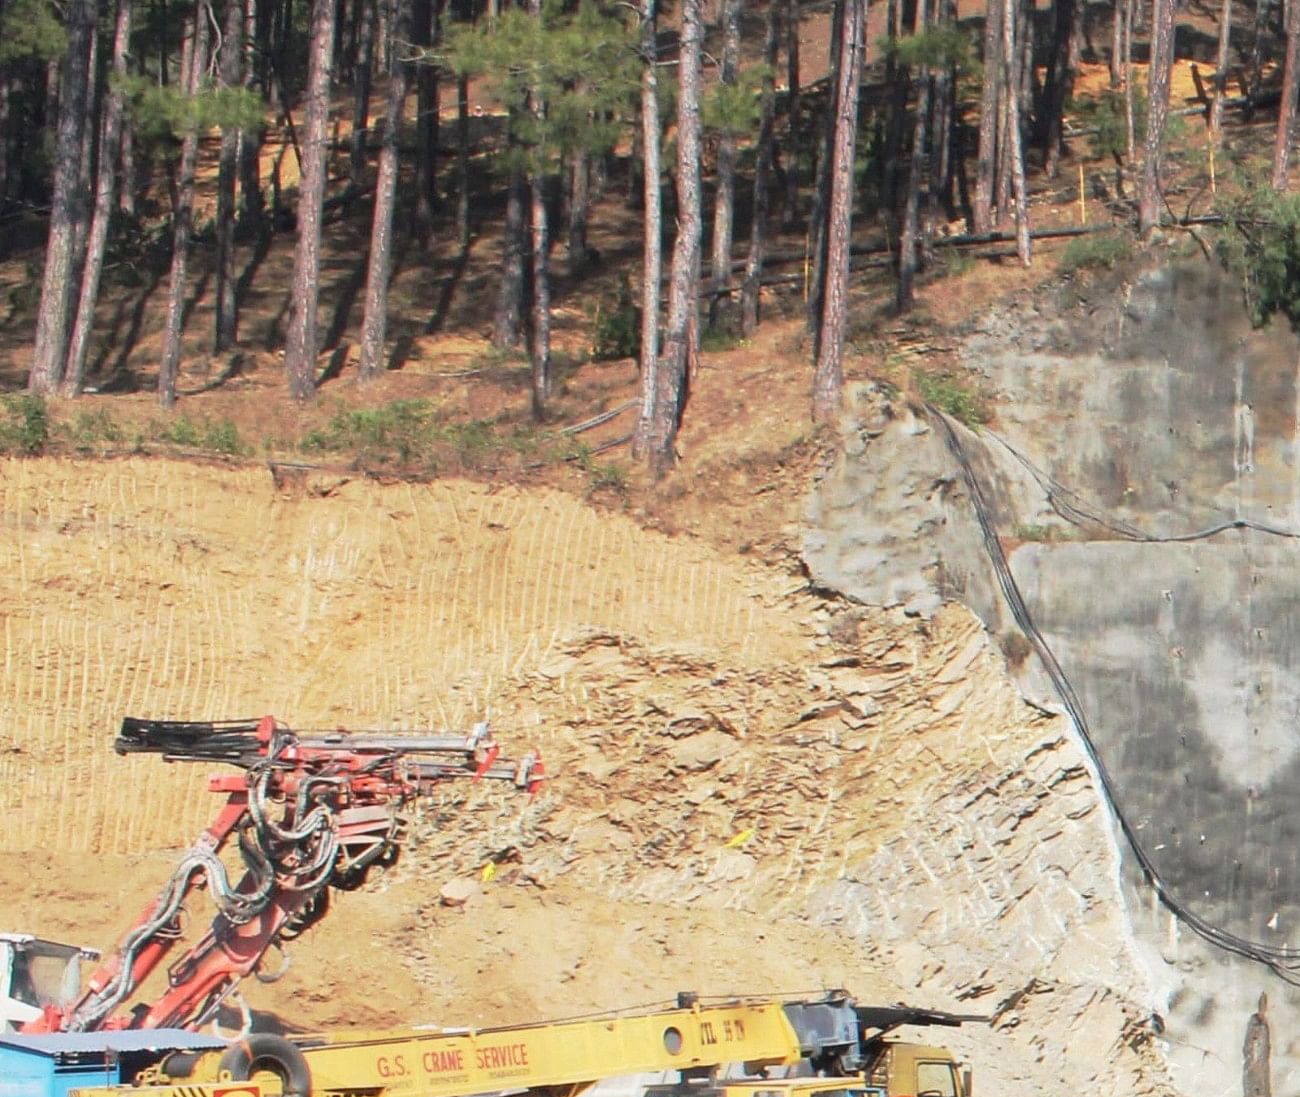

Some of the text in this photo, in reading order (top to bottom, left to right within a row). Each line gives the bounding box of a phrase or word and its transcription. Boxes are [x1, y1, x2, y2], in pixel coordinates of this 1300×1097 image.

[377, 1044, 529, 1078] G.S. CRANE SERVICE
